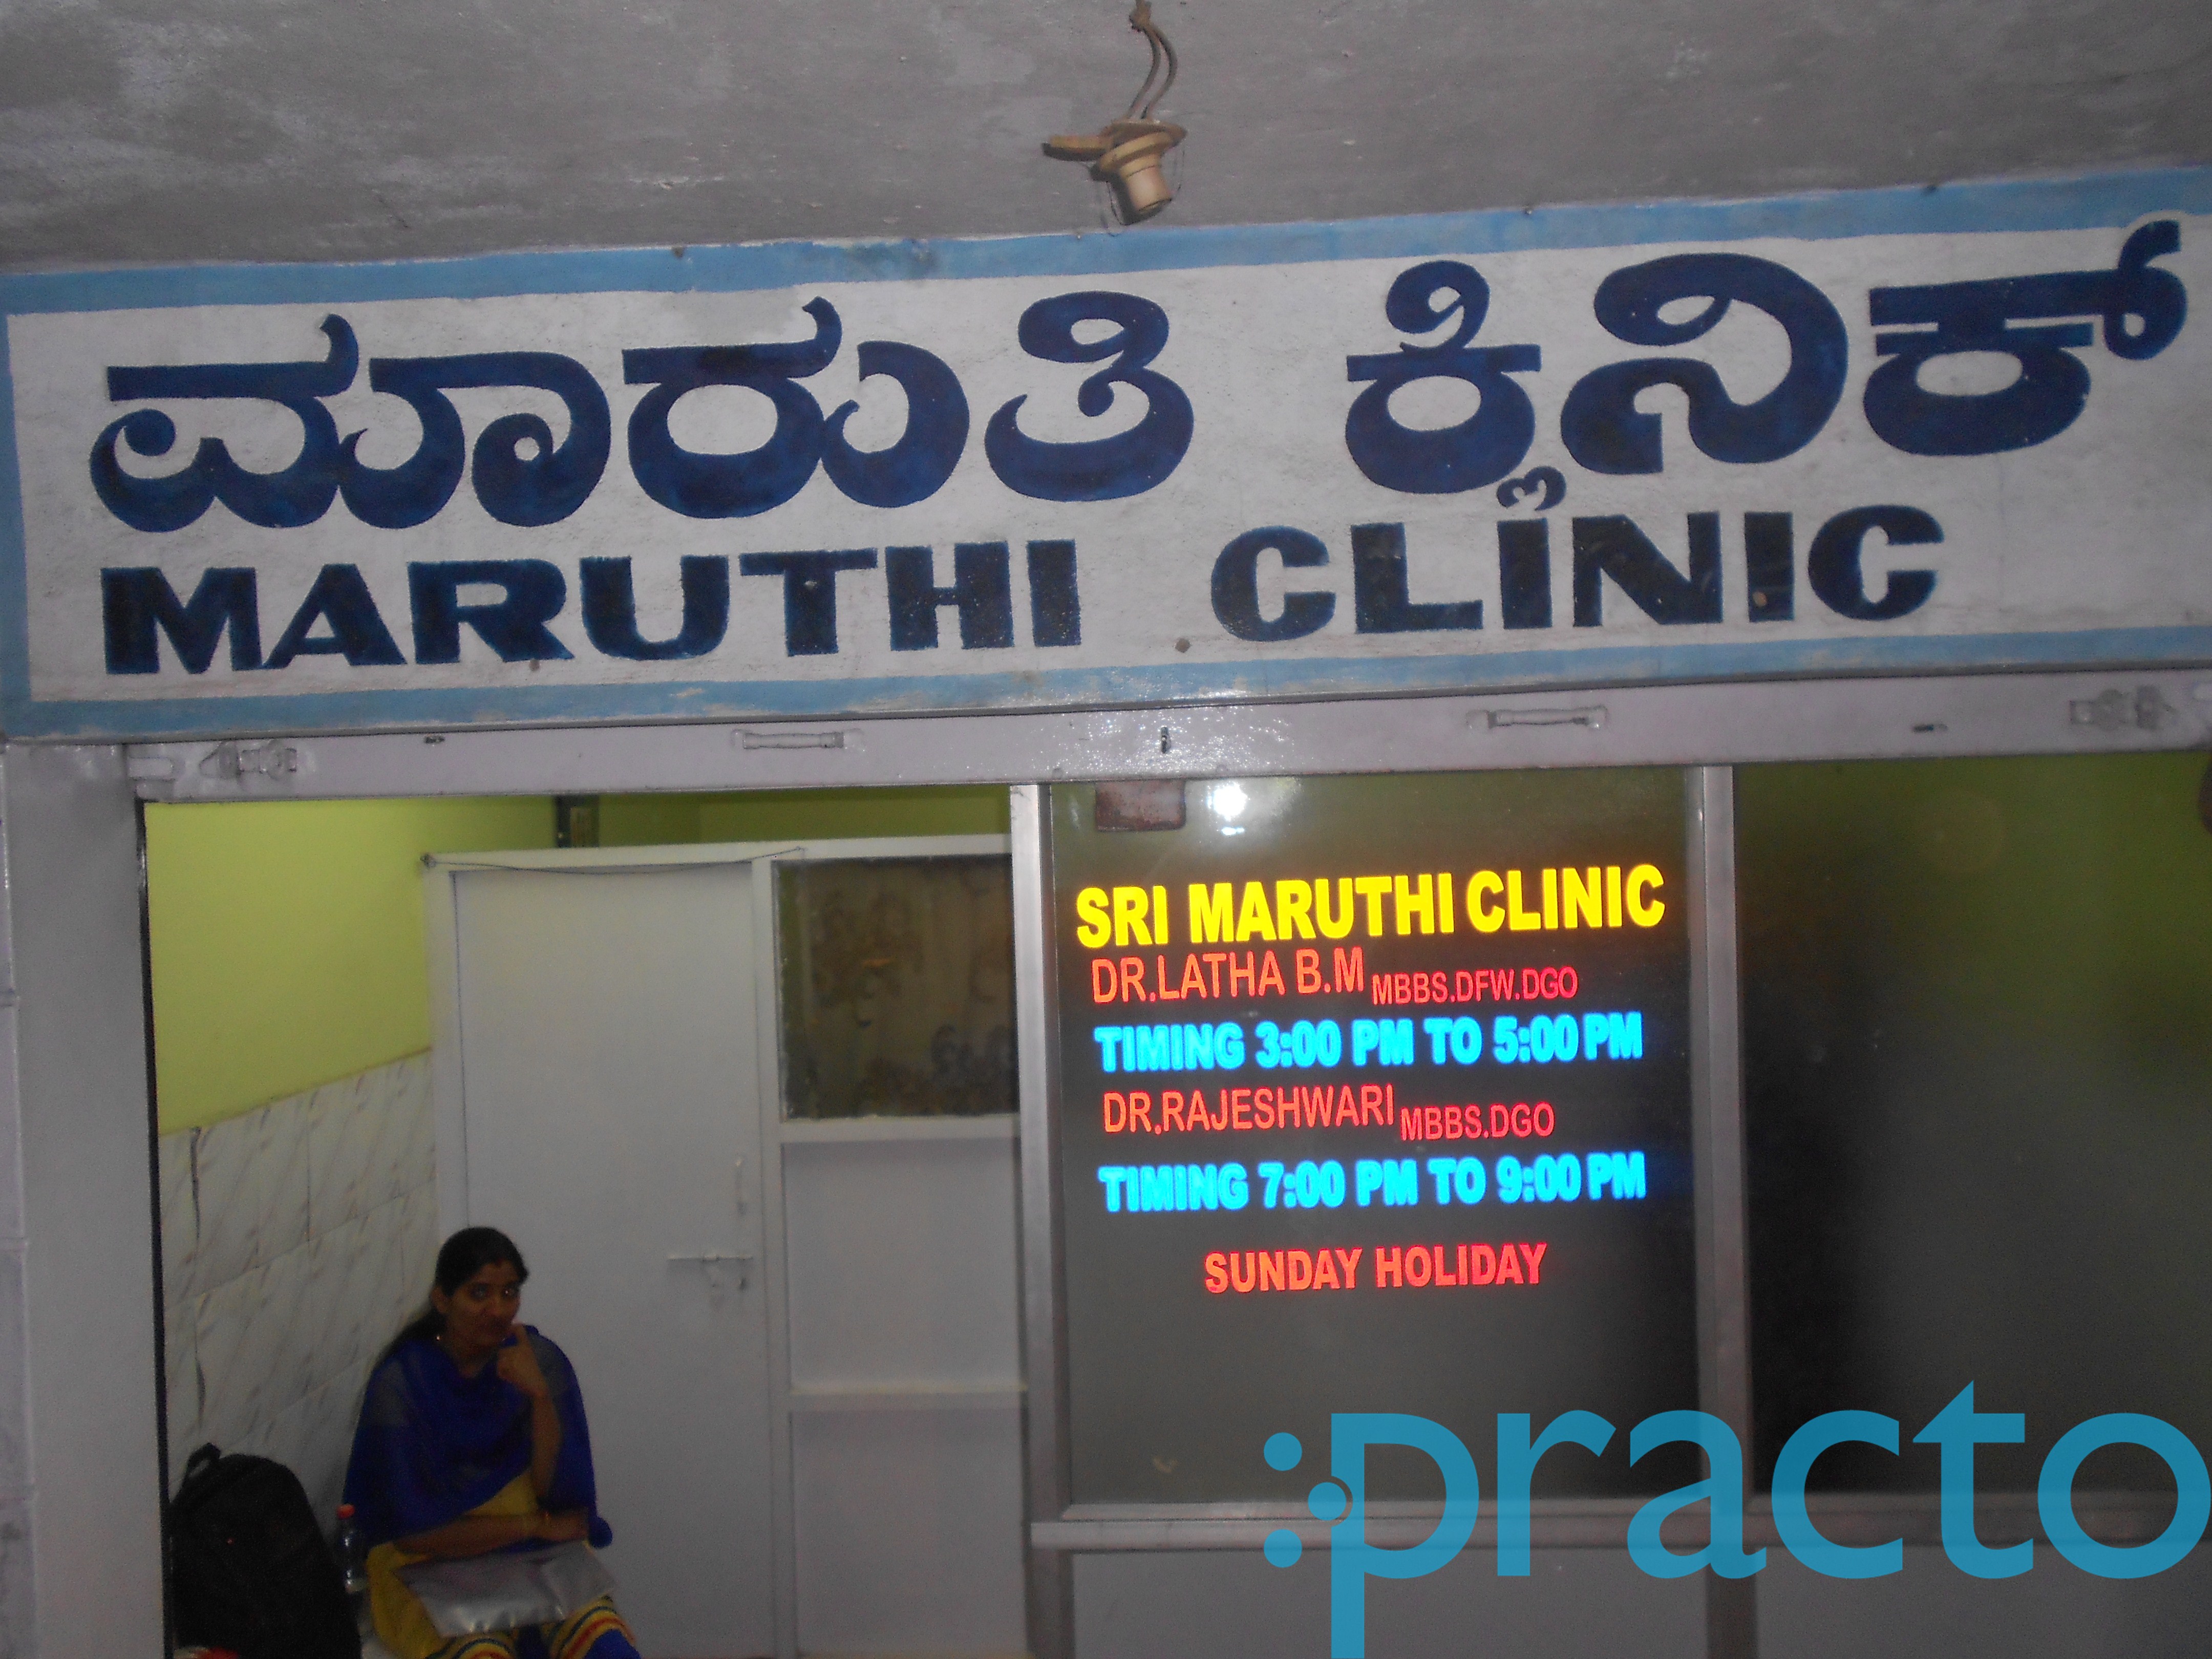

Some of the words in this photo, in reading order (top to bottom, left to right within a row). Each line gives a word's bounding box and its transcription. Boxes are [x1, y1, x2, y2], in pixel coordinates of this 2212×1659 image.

[89, 289, 1195, 531] ಮಾರುತಿ
[100, 539, 1082, 676] MARUTHI
[1209, 503, 1946, 642] CLINIC
[1076, 886, 1168, 948] SRI
[1188, 872, 1454, 944] MARUTHI
[1466, 864, 1667, 933] CLINIC
[1091, 950, 1286, 1004] DR.LATHA
[1295, 946, 1365, 996] B.M
[1371, 966, 1579, 1006] MBBS.DFW.DGO
[1094, 1023, 1245, 1072] TIMING
[1256, 1020, 1342, 1067] 3:00
[1352, 1018, 1413, 1065] PM
[1425, 1016, 1482, 1064] TO
[1493, 1015, 1579, 1063] 5:00
[1584, 1011, 1644, 1059] PM
[1103, 1083, 1395, 1135] DR.RAJESHWARI
[1400, 1102, 1556, 1141] MBBS.DGO
[1098, 1163, 1249, 1212] TIMING
[1259, 1160, 1346, 1208] 7:00
[1355, 1158, 1417, 1206] PM
[1429, 1156, 1486, 1204] TO
[1497, 1154, 1582, 1202] 9:00
[1587, 1151, 1647, 1199] PM
[1205, 1247, 1363, 1293] SUNDAY
[1375, 1243, 1548, 1288] HOLIDAY
